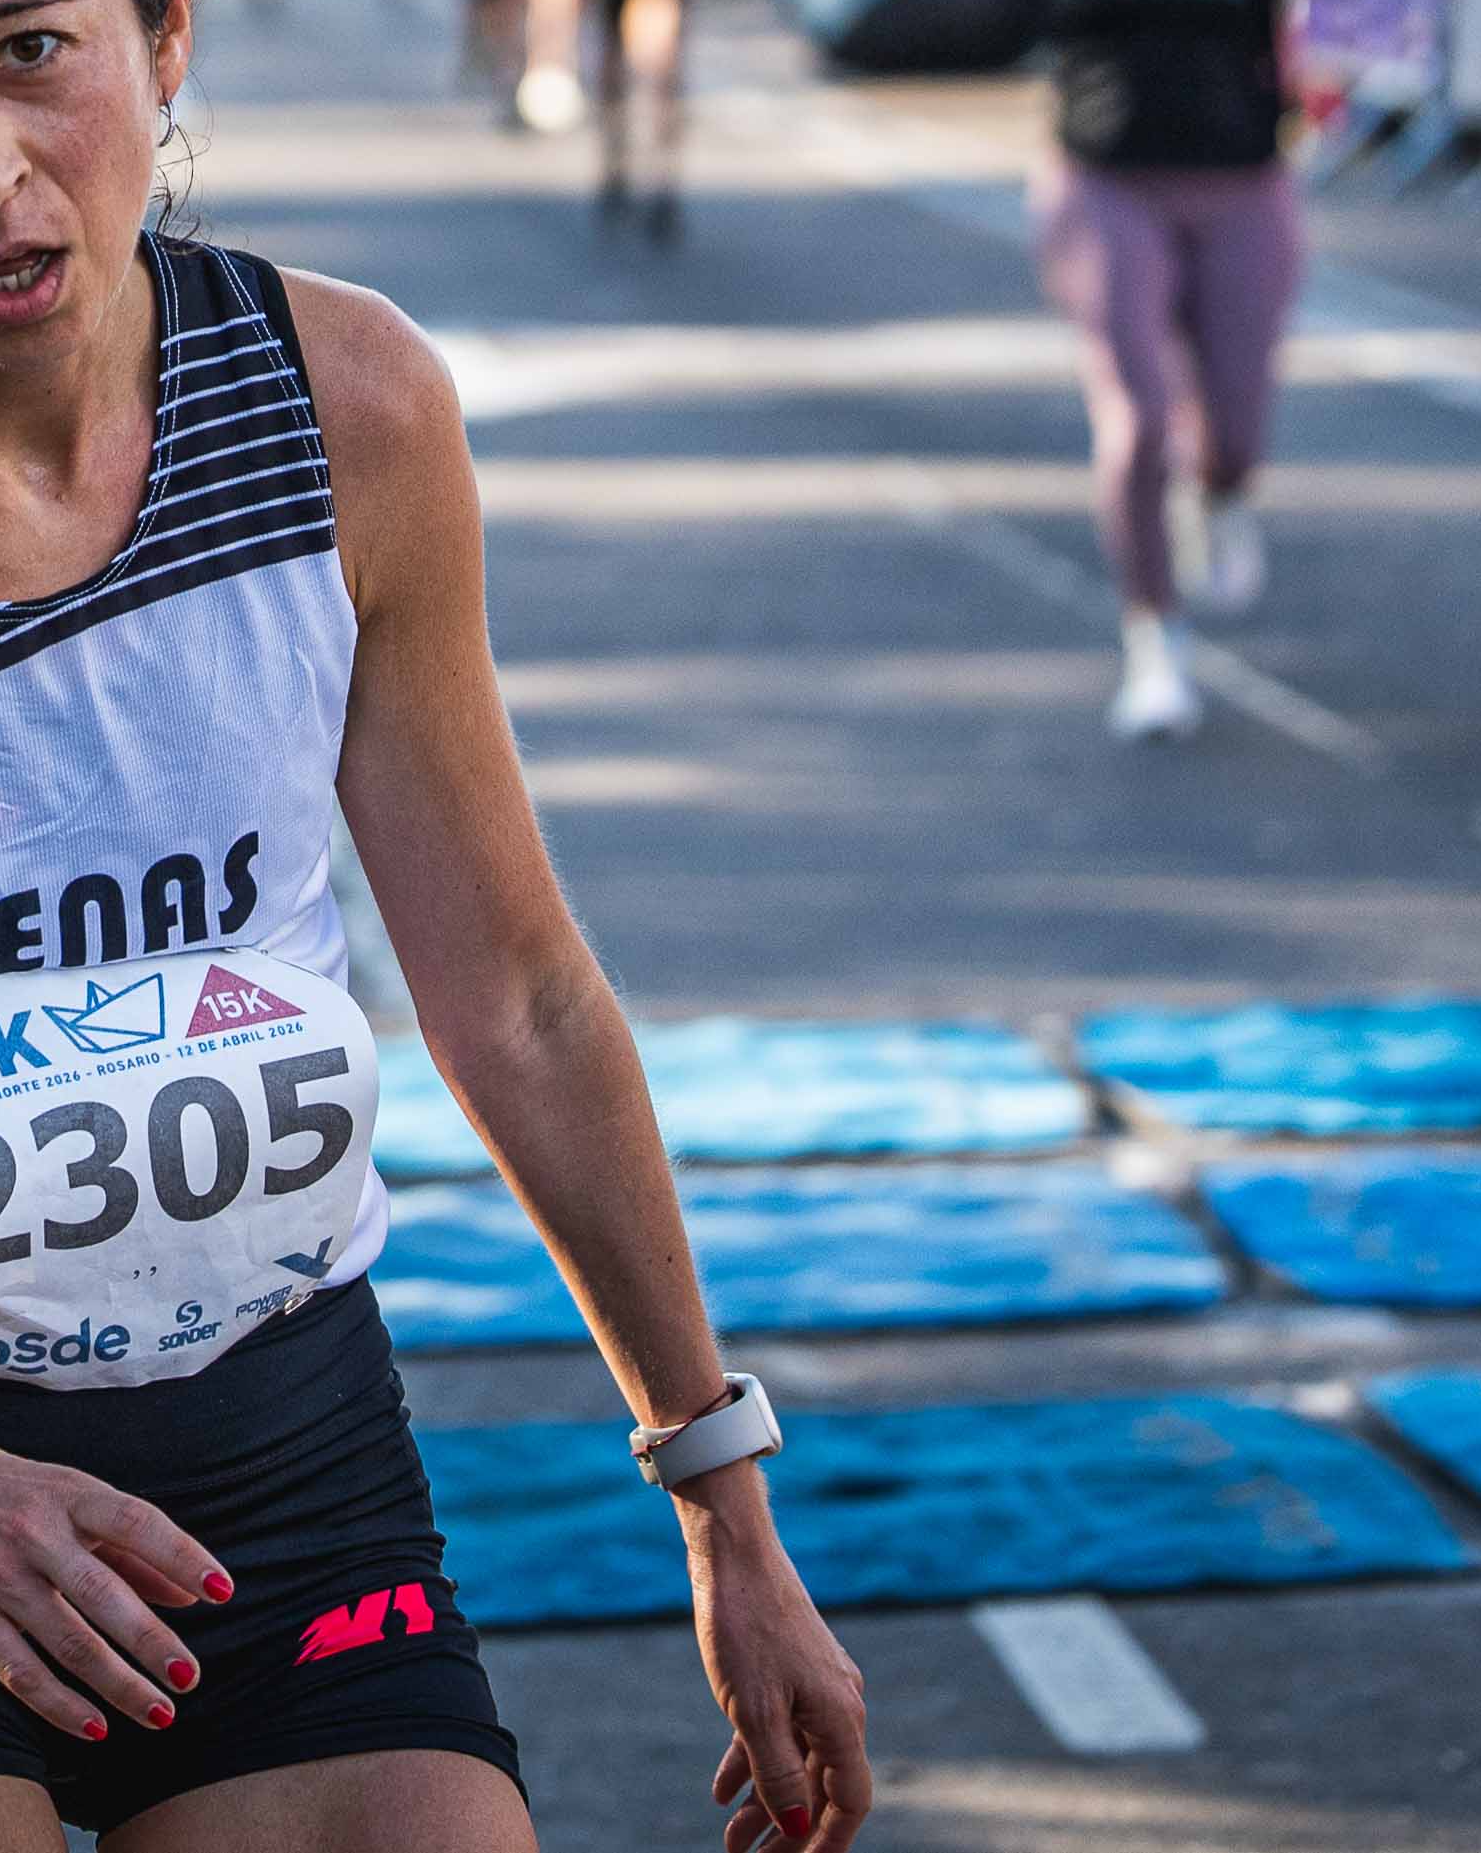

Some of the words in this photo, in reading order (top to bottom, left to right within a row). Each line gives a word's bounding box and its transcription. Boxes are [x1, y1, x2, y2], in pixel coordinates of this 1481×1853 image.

[201, 987, 273, 1022] 15K
[44, 1071, 82, 1088] 2026
[96, 1051, 161, 1077] ROSARIO
[176, 1045, 194, 1058] 12
[198, 1039, 218, 1055] DE
[222, 1030, 265, 1049] ABRIL
[269, 1021, 304, 1038] 2026
[235, 1283, 294, 1319] POWER
